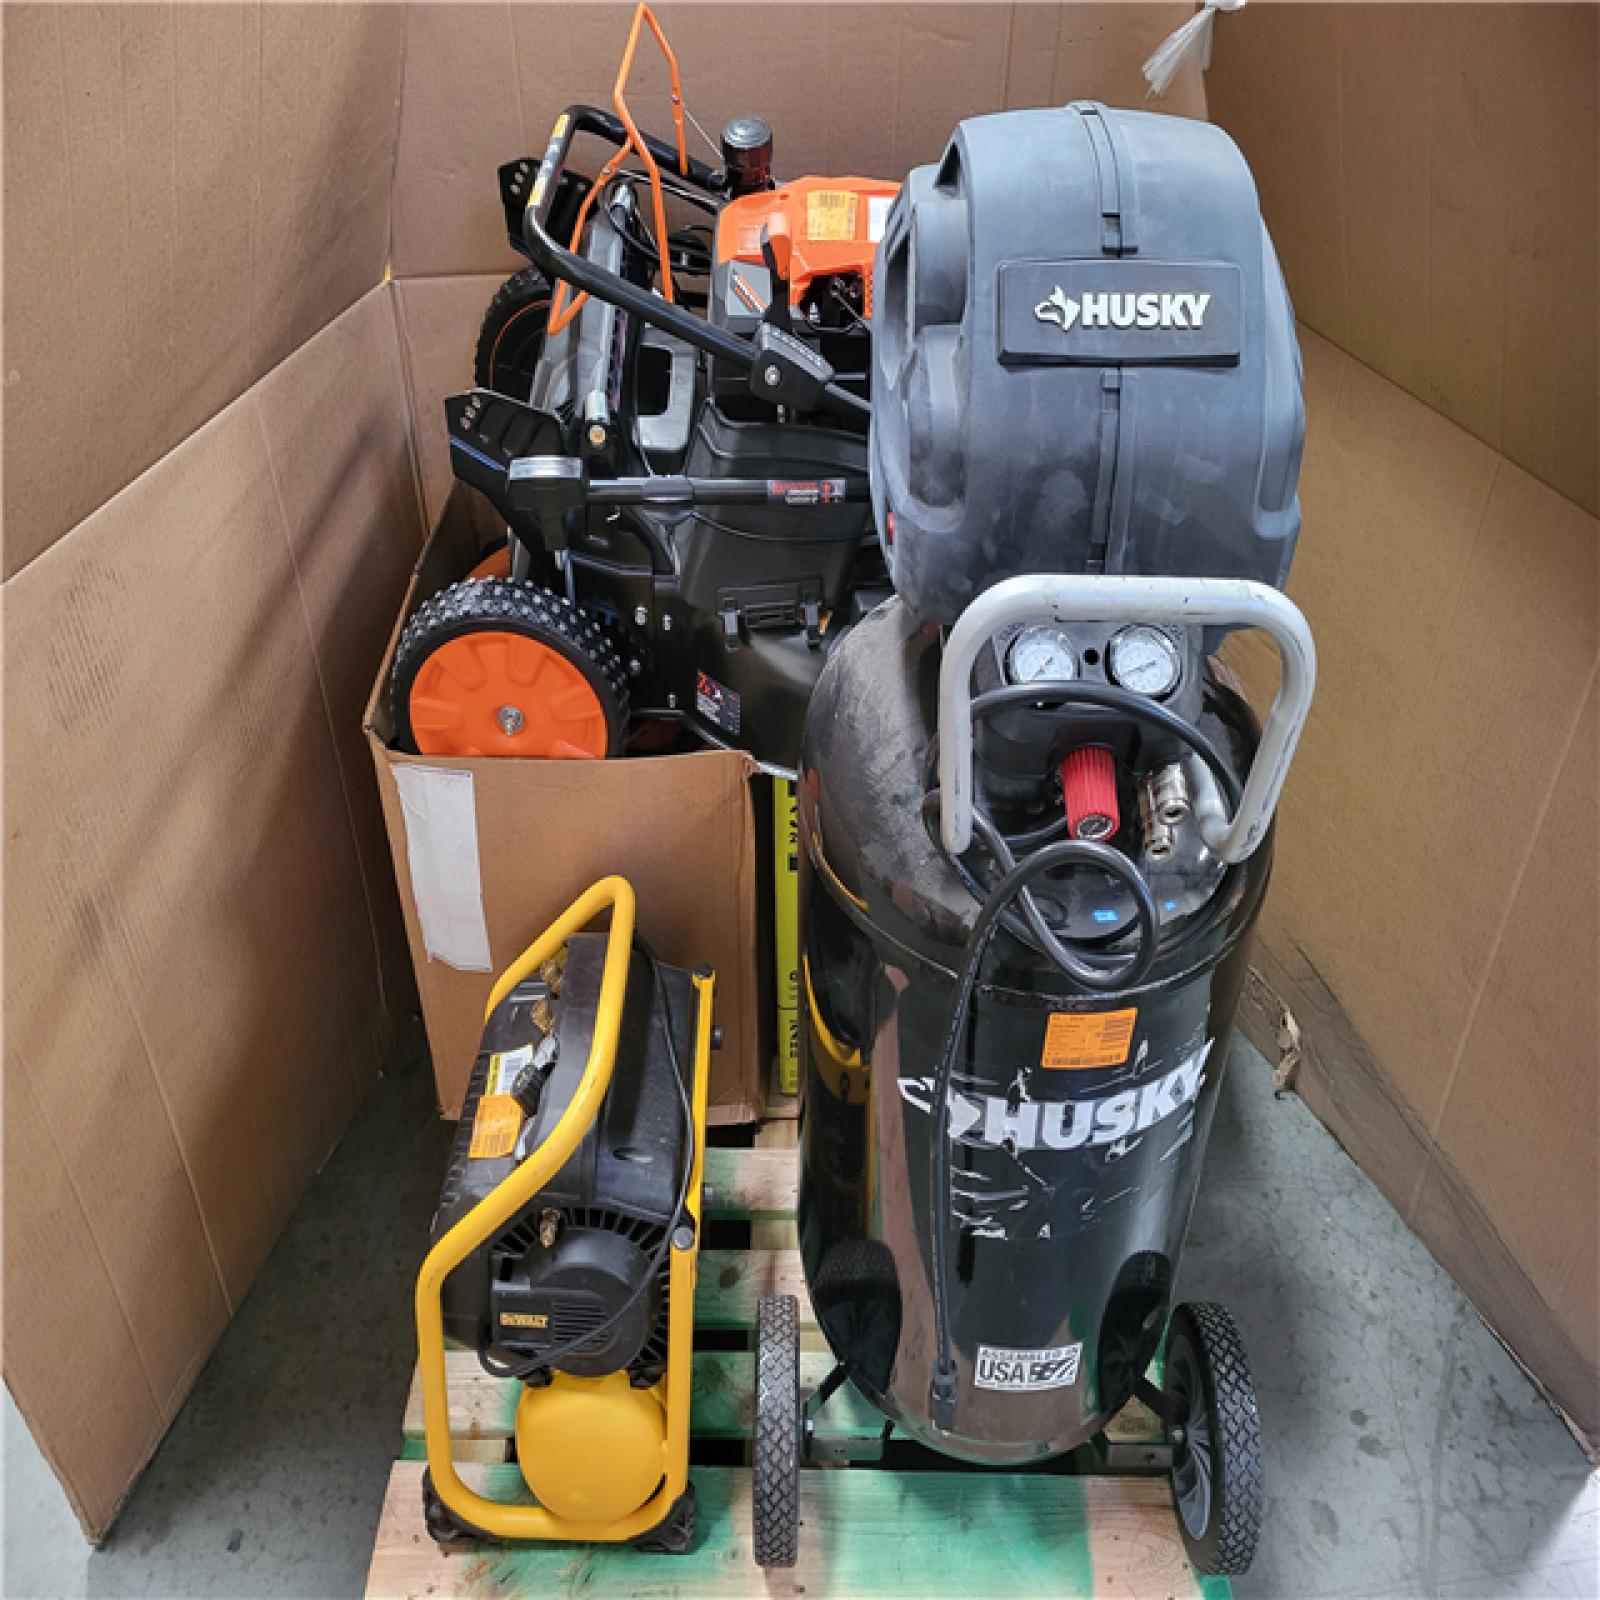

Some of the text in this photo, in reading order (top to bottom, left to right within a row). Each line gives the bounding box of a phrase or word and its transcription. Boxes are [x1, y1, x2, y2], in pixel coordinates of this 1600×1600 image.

[1082, 291, 1211, 329] HUSKY
[983, 1037, 1216, 1151] HUSKY
[979, 1360, 1025, 1383] USA
